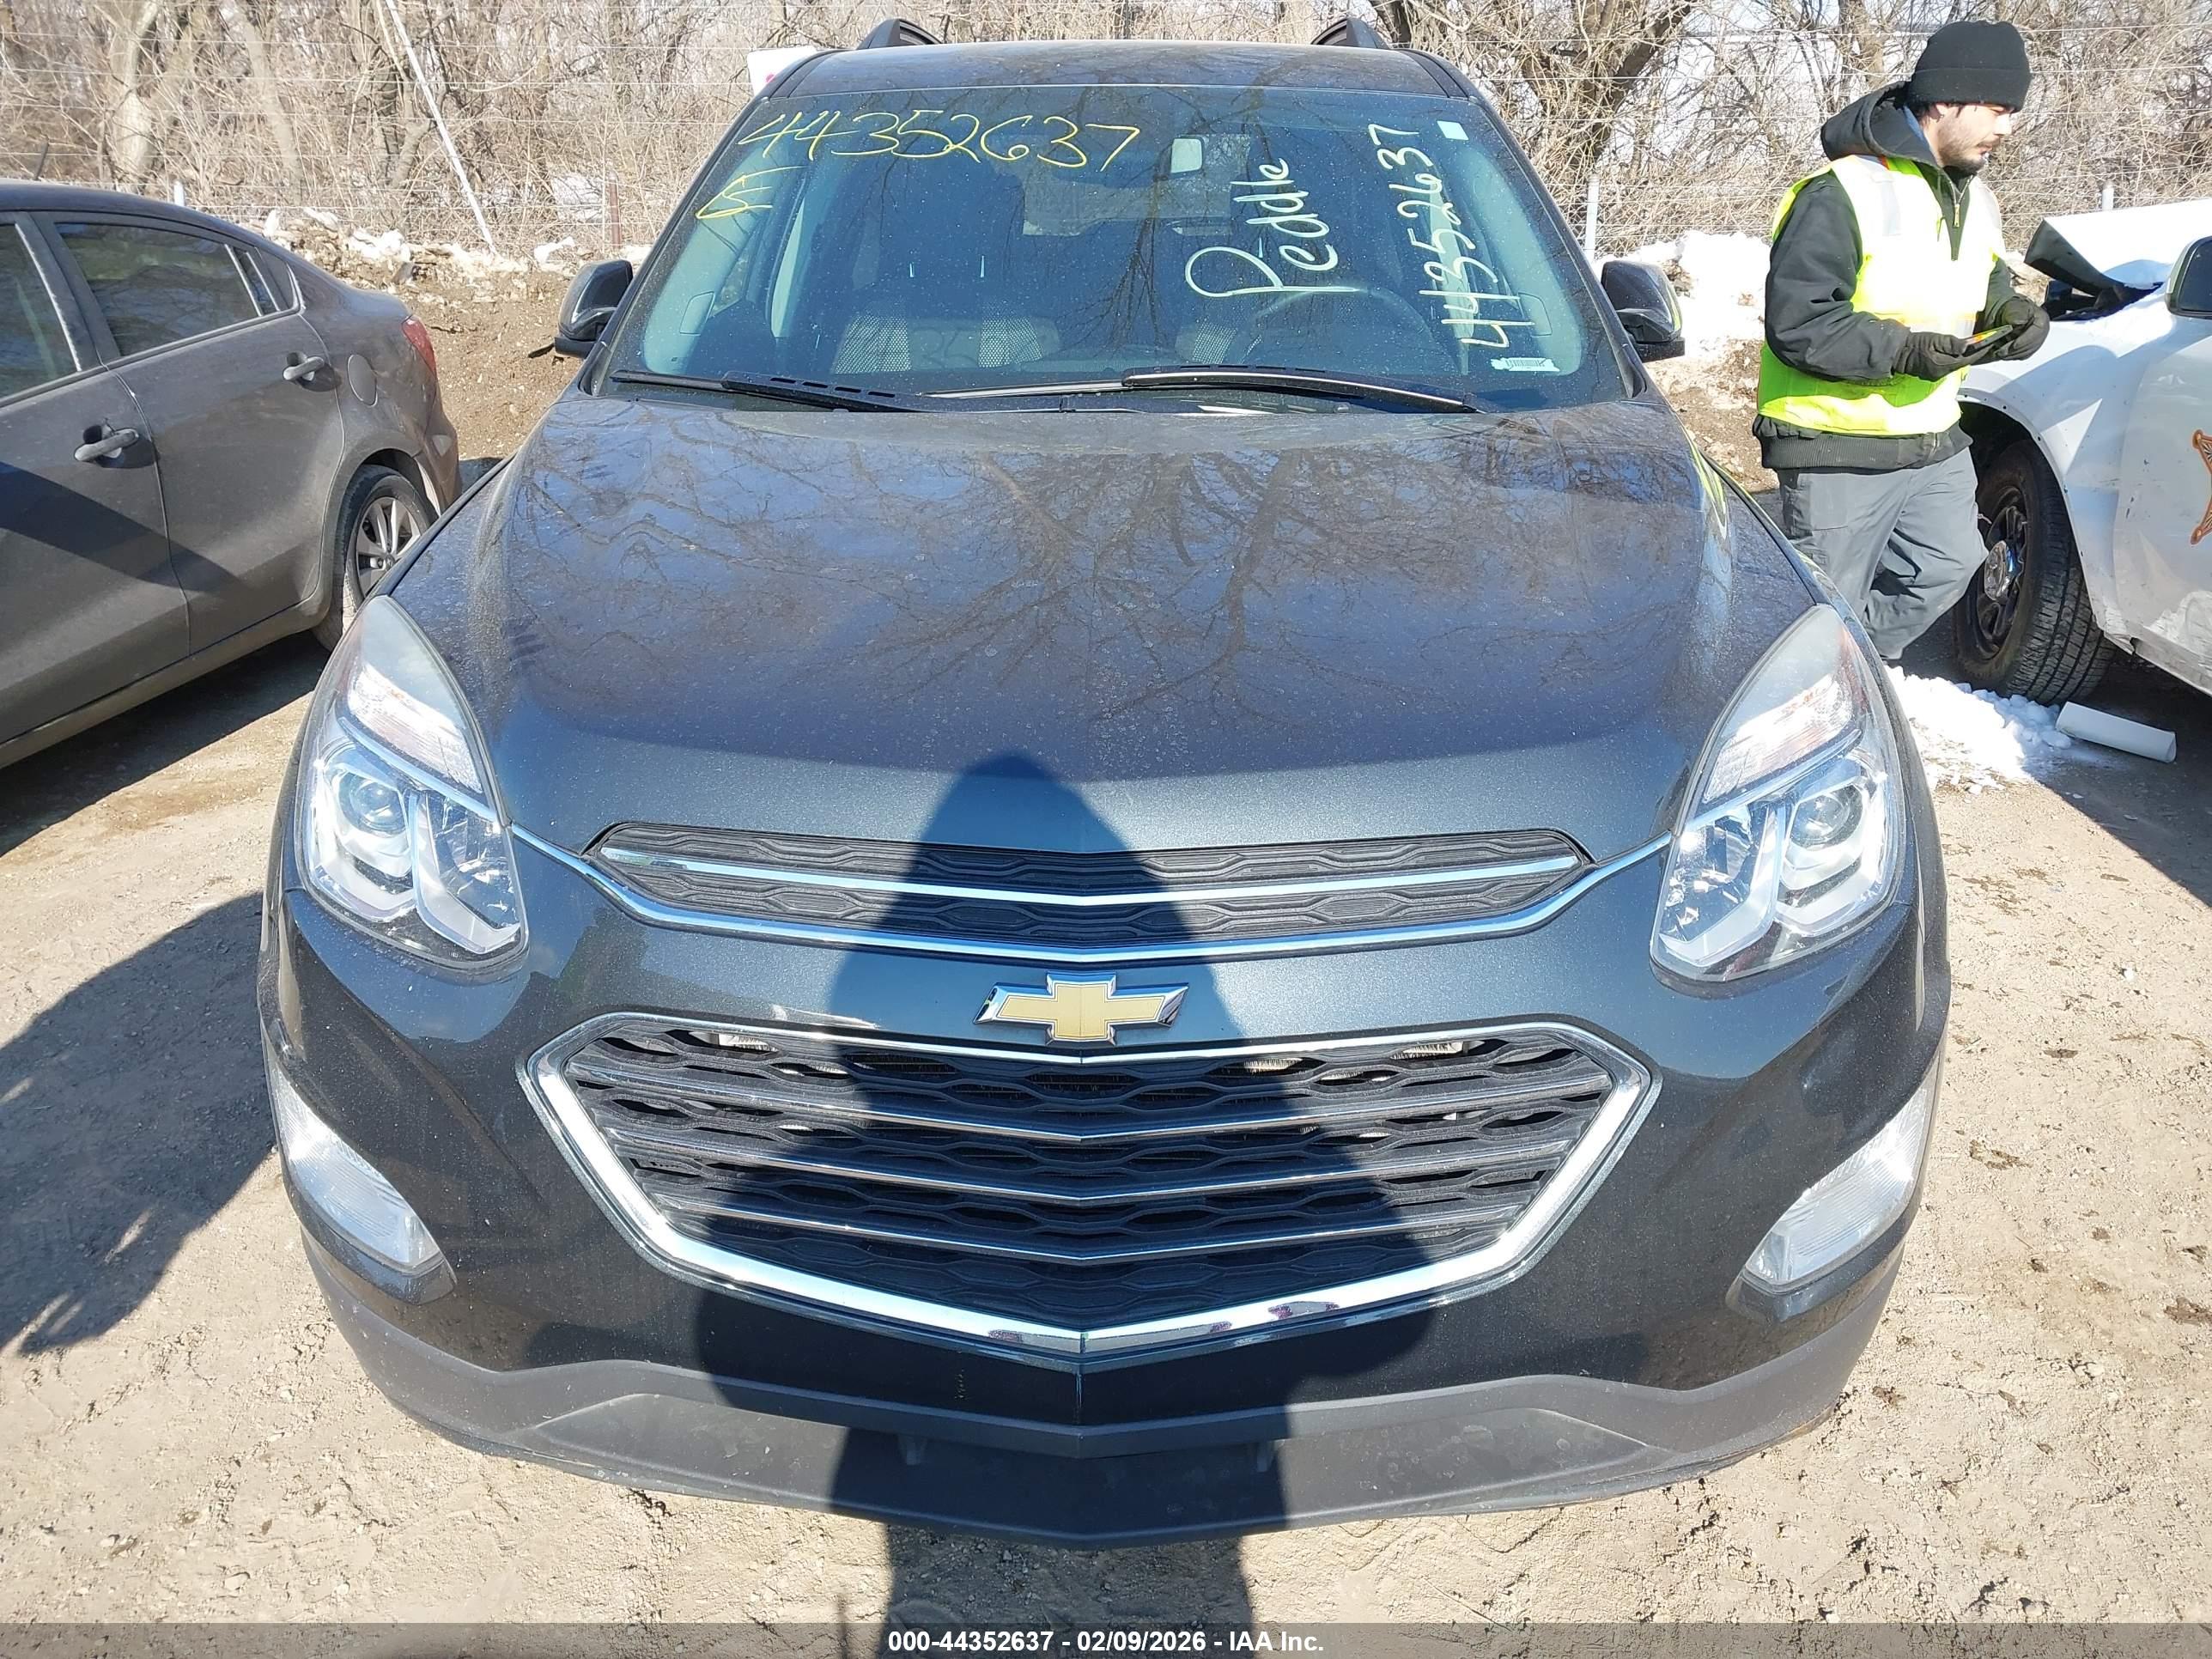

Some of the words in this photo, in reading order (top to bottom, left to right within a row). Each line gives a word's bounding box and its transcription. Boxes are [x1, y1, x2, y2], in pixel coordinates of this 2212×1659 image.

[737, 108, 1141, 173] 44352637
[1184, 157, 1359, 298] Peddle
[1368, 122, 1535, 348] 44352637
